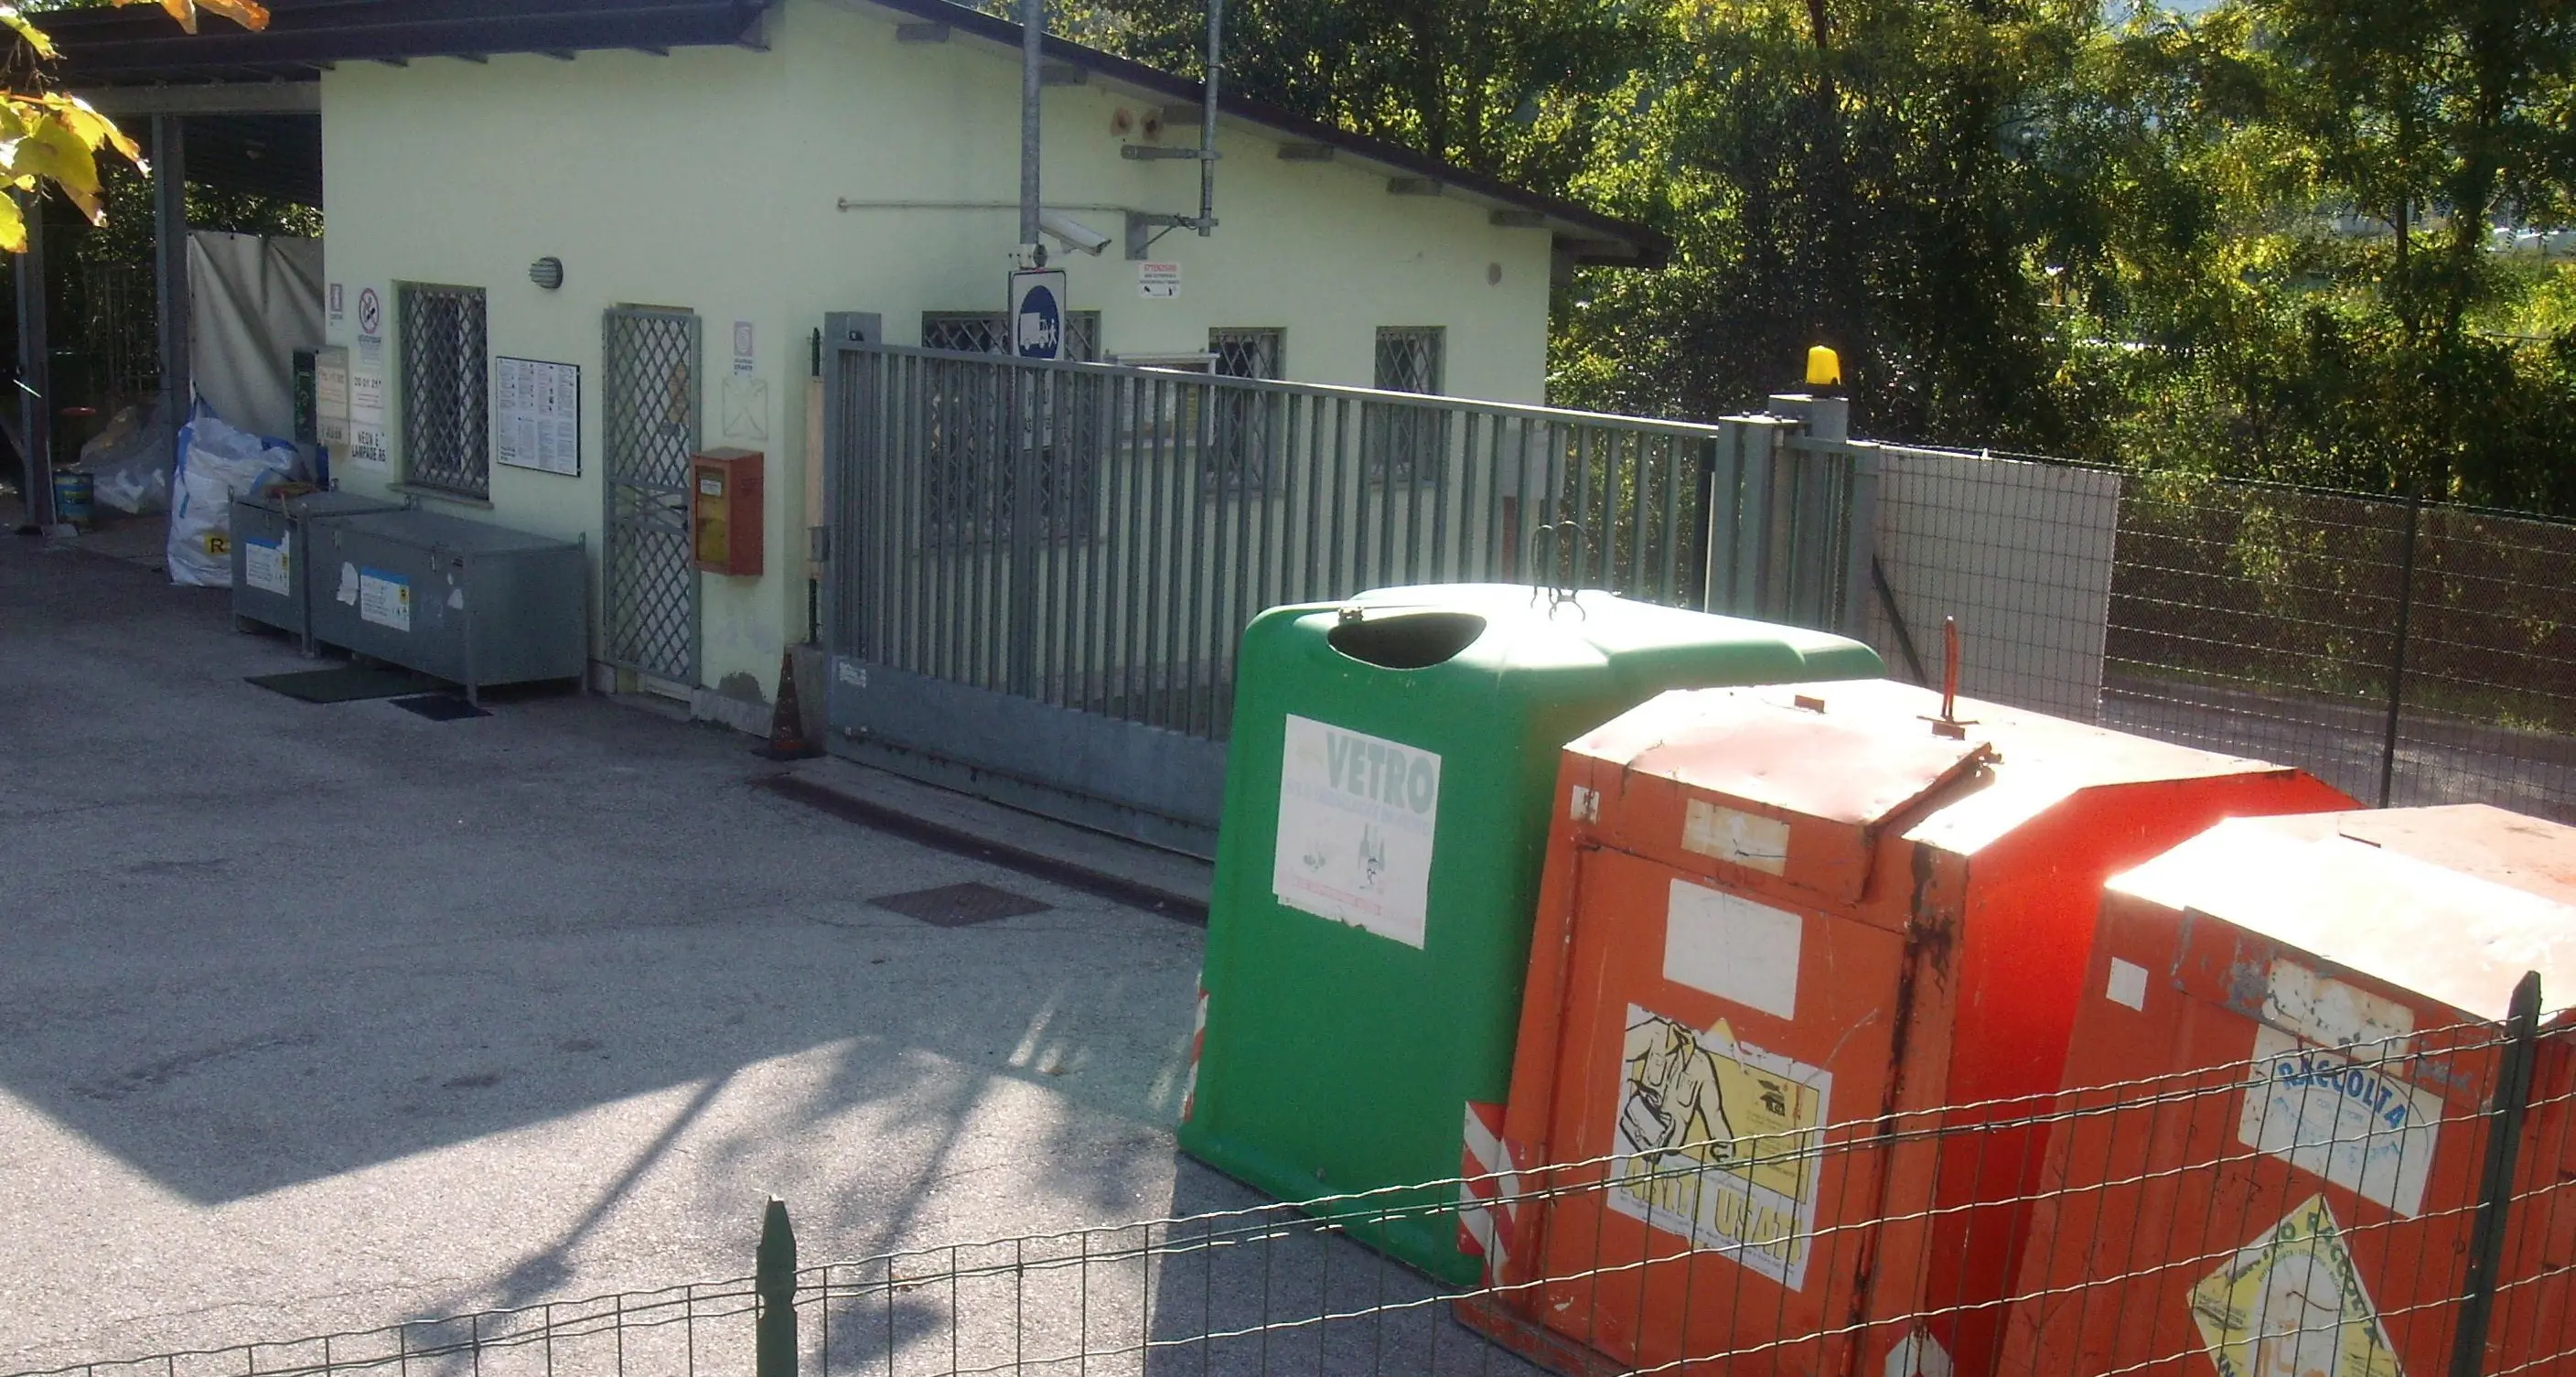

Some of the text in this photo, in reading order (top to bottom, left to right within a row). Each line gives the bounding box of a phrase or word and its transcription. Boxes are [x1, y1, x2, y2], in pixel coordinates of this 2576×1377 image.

[209, 538, 225, 554] R
[1326, 731, 1435, 815] VETRO
[2276, 1060, 2407, 1130] RACCOLTA
